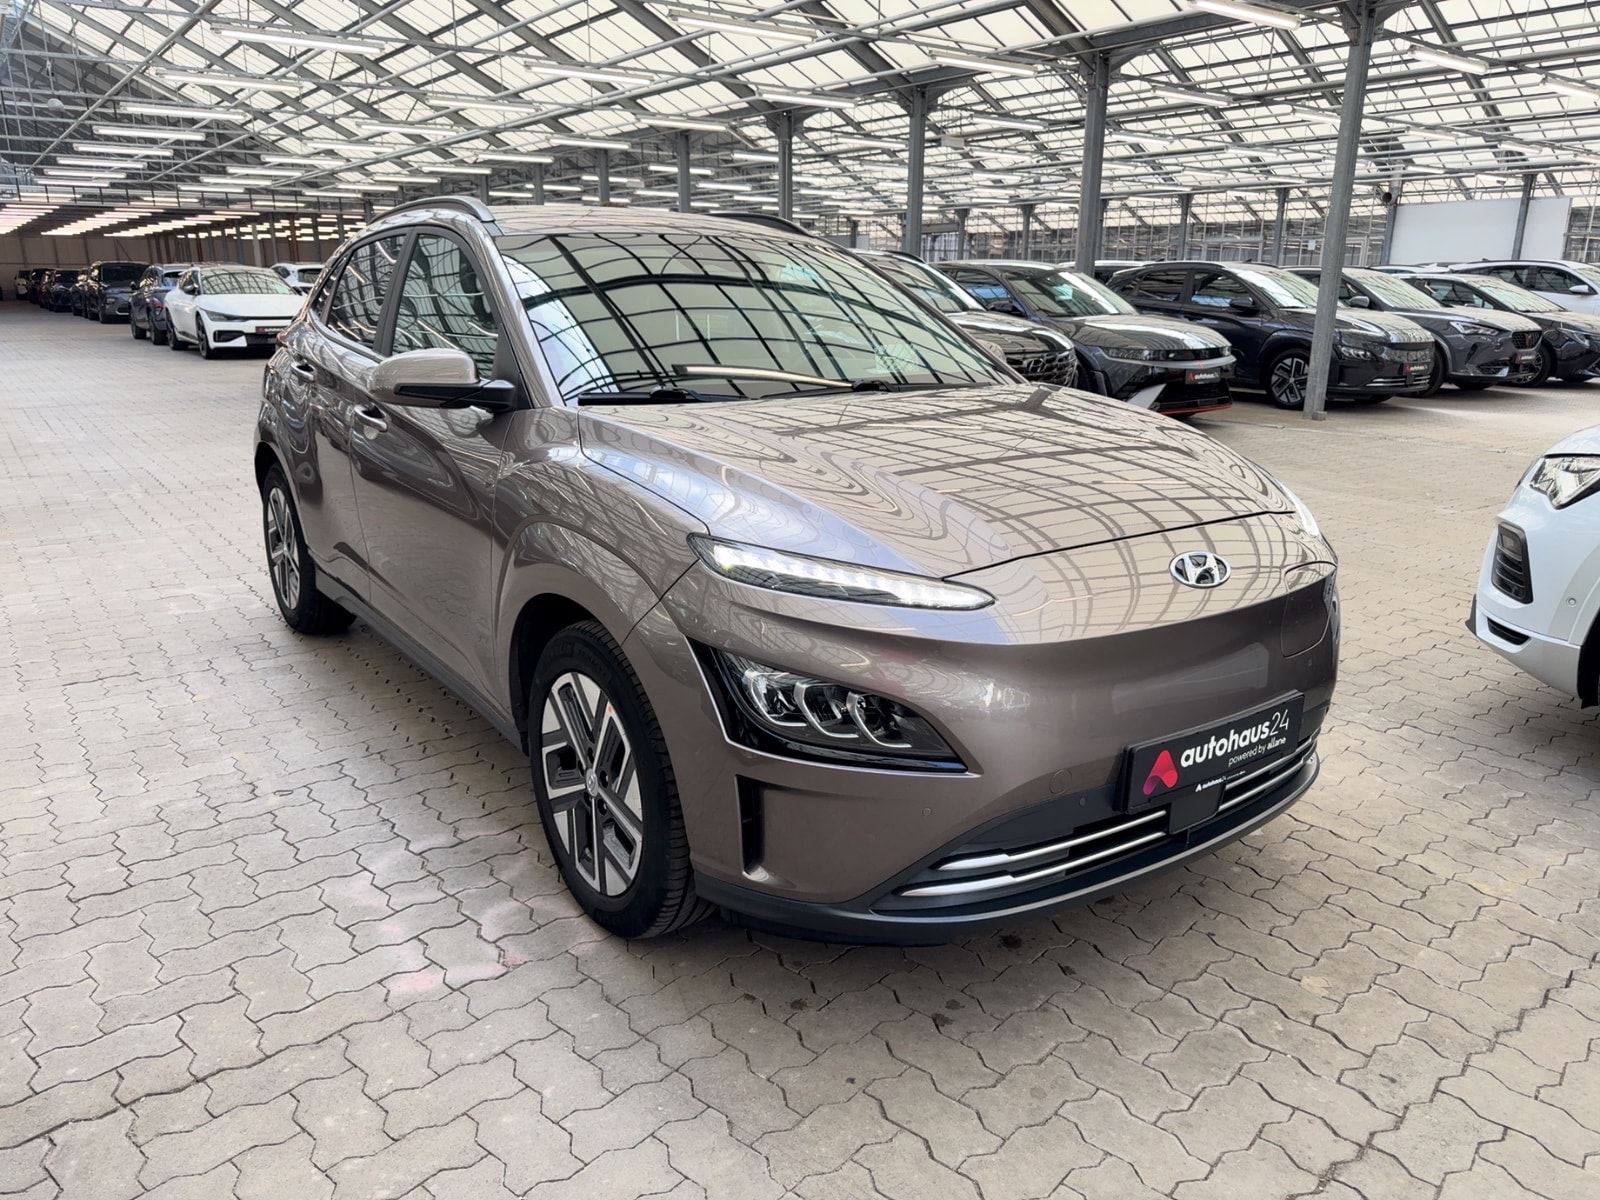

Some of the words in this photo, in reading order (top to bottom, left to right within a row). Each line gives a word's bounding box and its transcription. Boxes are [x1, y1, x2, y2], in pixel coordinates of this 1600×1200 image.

[1180, 709, 1290, 768] autohaus24
[1228, 745, 1258, 768] powered
[1258, 743, 1266, 755] by
[1266, 736, 1287, 751] allane
